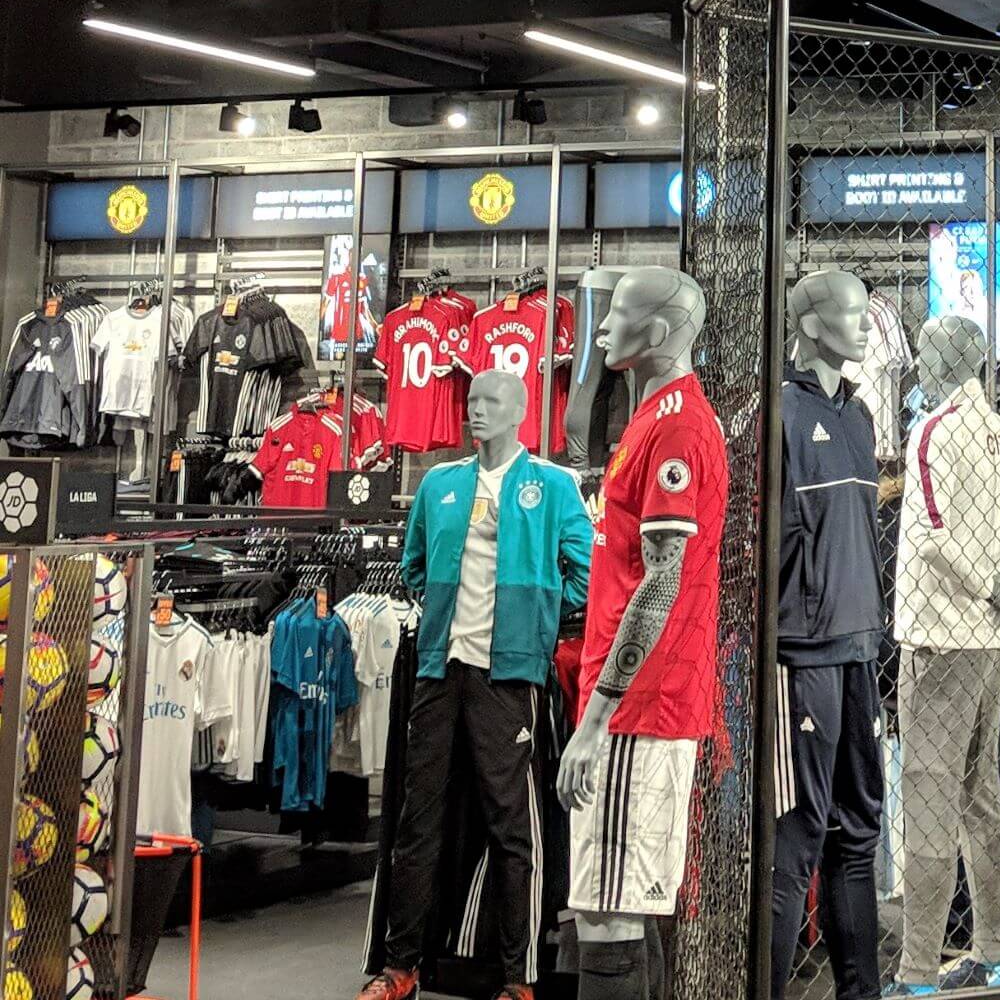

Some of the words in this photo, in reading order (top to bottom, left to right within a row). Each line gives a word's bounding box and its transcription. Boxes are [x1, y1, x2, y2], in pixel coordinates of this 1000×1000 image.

[484, 321, 536, 344] RASHFORD
[400, 341, 433, 389] 10
[489, 343, 529, 380] 19
[6, 495, 21, 508] JD
[79, 491, 98, 503] LIGA
